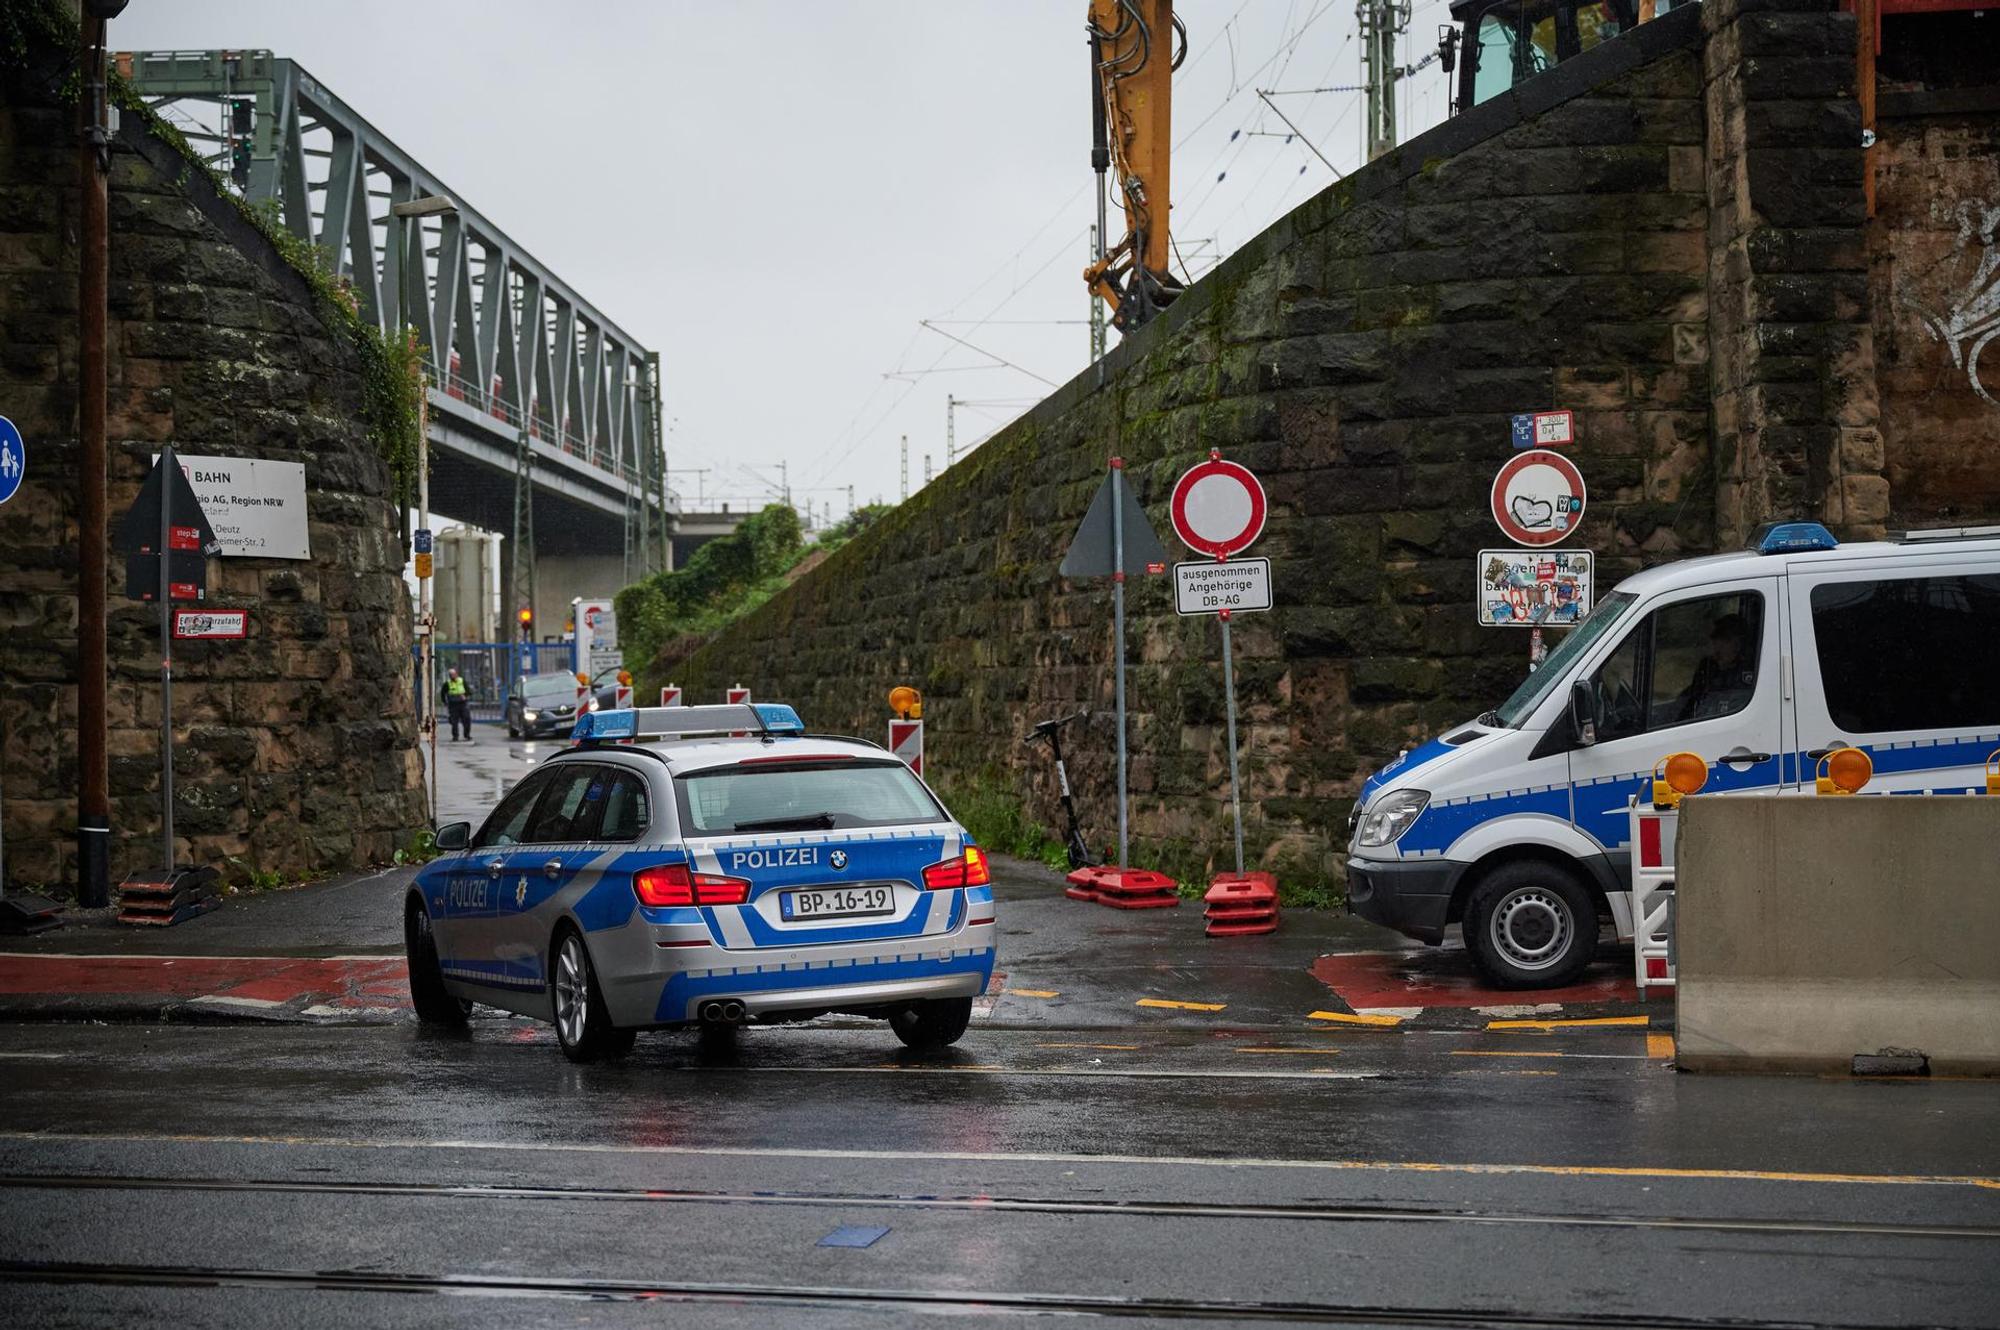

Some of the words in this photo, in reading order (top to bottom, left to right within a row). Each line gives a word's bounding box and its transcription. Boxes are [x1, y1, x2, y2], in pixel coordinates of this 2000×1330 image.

[195, 471, 231, 483] BAHN
[196, 494, 209, 504] gio
[231, 495, 261, 507] Region
[263, 497, 284, 507] NRW
[212, 524, 240, 534] -Deutz
[218, 537, 259, 547] eimer-Str.
[259, 539, 266, 547] 2
[1182, 566, 1260, 580] ausgenommen
[1188, 580, 1252, 594] Angehörige
[1202, 594, 1240, 606] DB-AG
[733, 847, 818, 870] POLIZEI
[449, 879, 488, 908] POLIZEI
